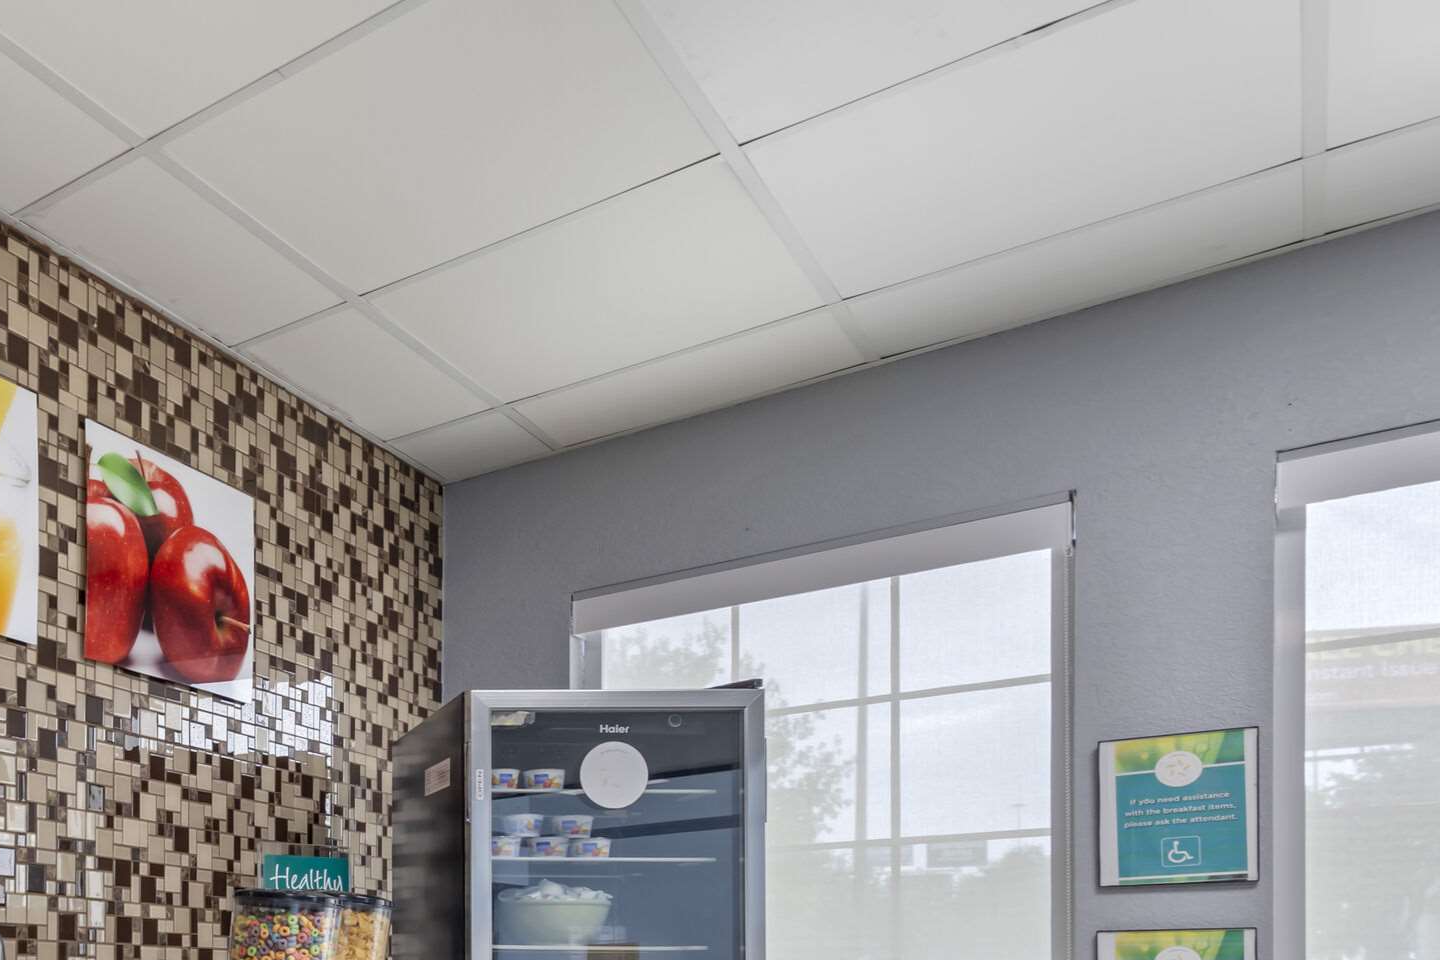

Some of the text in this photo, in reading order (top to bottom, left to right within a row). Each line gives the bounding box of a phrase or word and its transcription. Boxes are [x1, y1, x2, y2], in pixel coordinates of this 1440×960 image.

[599, 724, 630, 734] Haier
[1138, 799, 1155, 807] you
[1182, 791, 1231, 801] assistance
[1163, 804, 1207, 814] breakfast
[1124, 820, 1153, 829] please
[1155, 818, 1170, 826] ask
